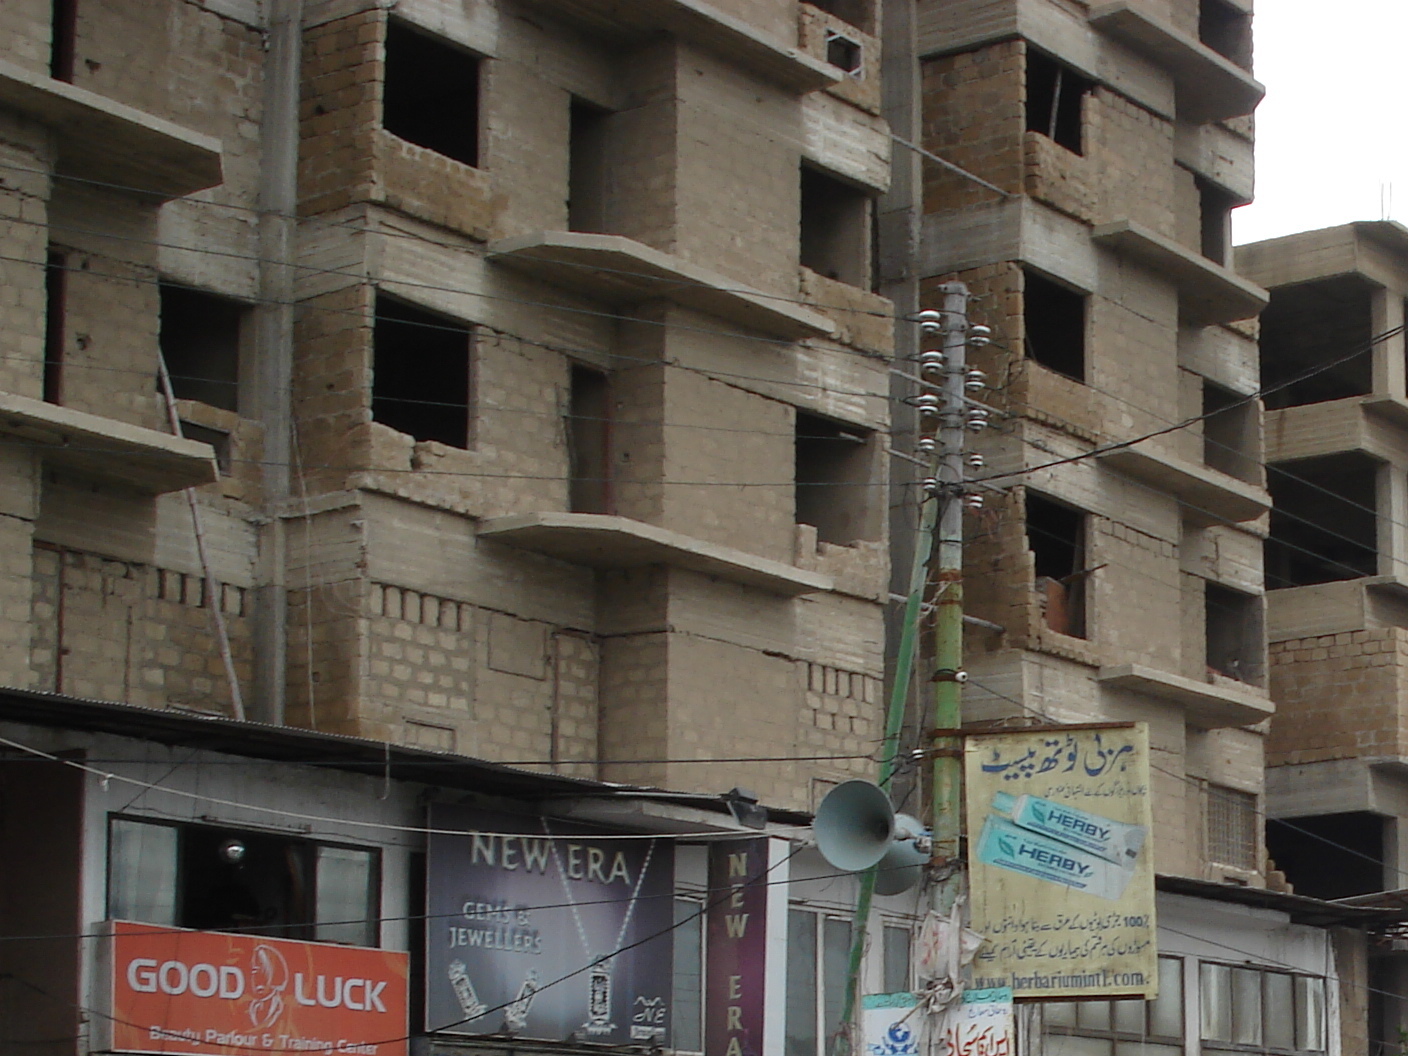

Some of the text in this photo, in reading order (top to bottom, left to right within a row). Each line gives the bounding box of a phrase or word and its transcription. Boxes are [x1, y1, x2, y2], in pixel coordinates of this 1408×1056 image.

[1047, 810, 1112, 841] HERBY
[470, 832, 631, 885] NEW ERA
[1018, 844, 1091, 875] HERBY
[724, 852, 750, 939] NEW
[462, 901, 510, 924] GEMS
[449, 927, 542, 955] JEWELLERS
[127, 957, 388, 1014] GOOD LUCK
[149, 1026, 379, 1056] Beauty Parlour & Training Center
